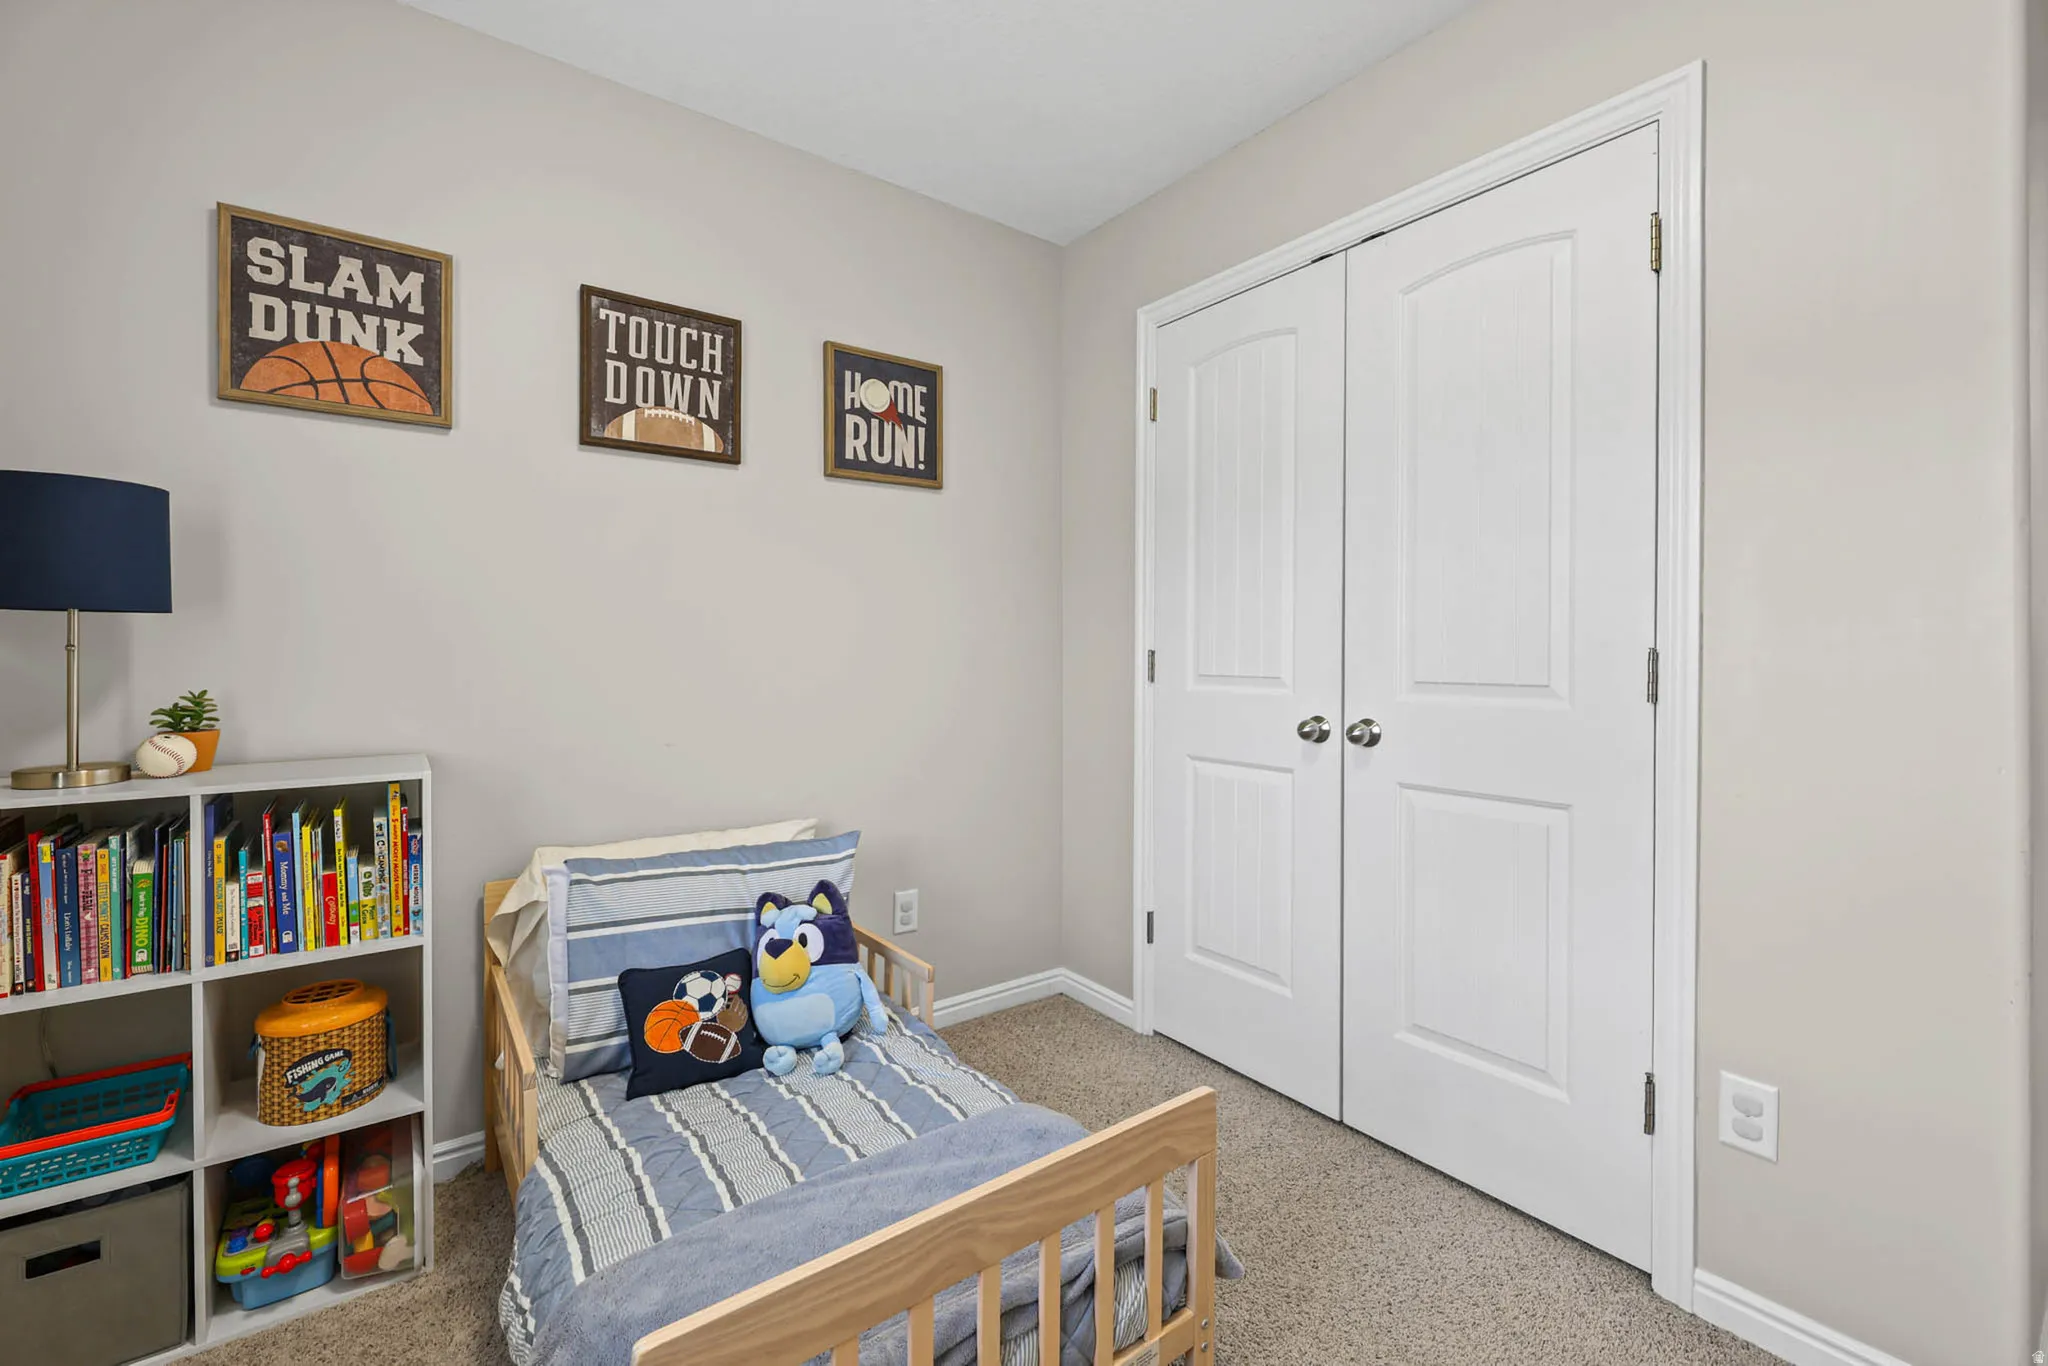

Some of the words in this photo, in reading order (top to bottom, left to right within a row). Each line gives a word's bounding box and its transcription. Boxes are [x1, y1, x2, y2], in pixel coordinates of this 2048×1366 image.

[247, 236, 424, 315] SLAM
[249, 292, 424, 366] DUNK
[599, 308, 724, 375] TOUCH
[604, 359, 722, 420] DOWN
[844, 370, 928, 424] HOME
[844, 413, 926, 471] RUN!
[279, 861, 289, 890] Mommy
[82, 890, 92, 911] FARM
[282, 903, 291, 915] Me
[64, 912, 72, 931] Lion's
[100, 923, 110, 941] CALMS
[135, 917, 149, 947] DINO
[64, 931, 73, 951] Lullaby
[100, 942, 110, 959] DOWN
[286, 1056, 324, 1084] FISHING
[324, 1050, 344, 1062] GAME
